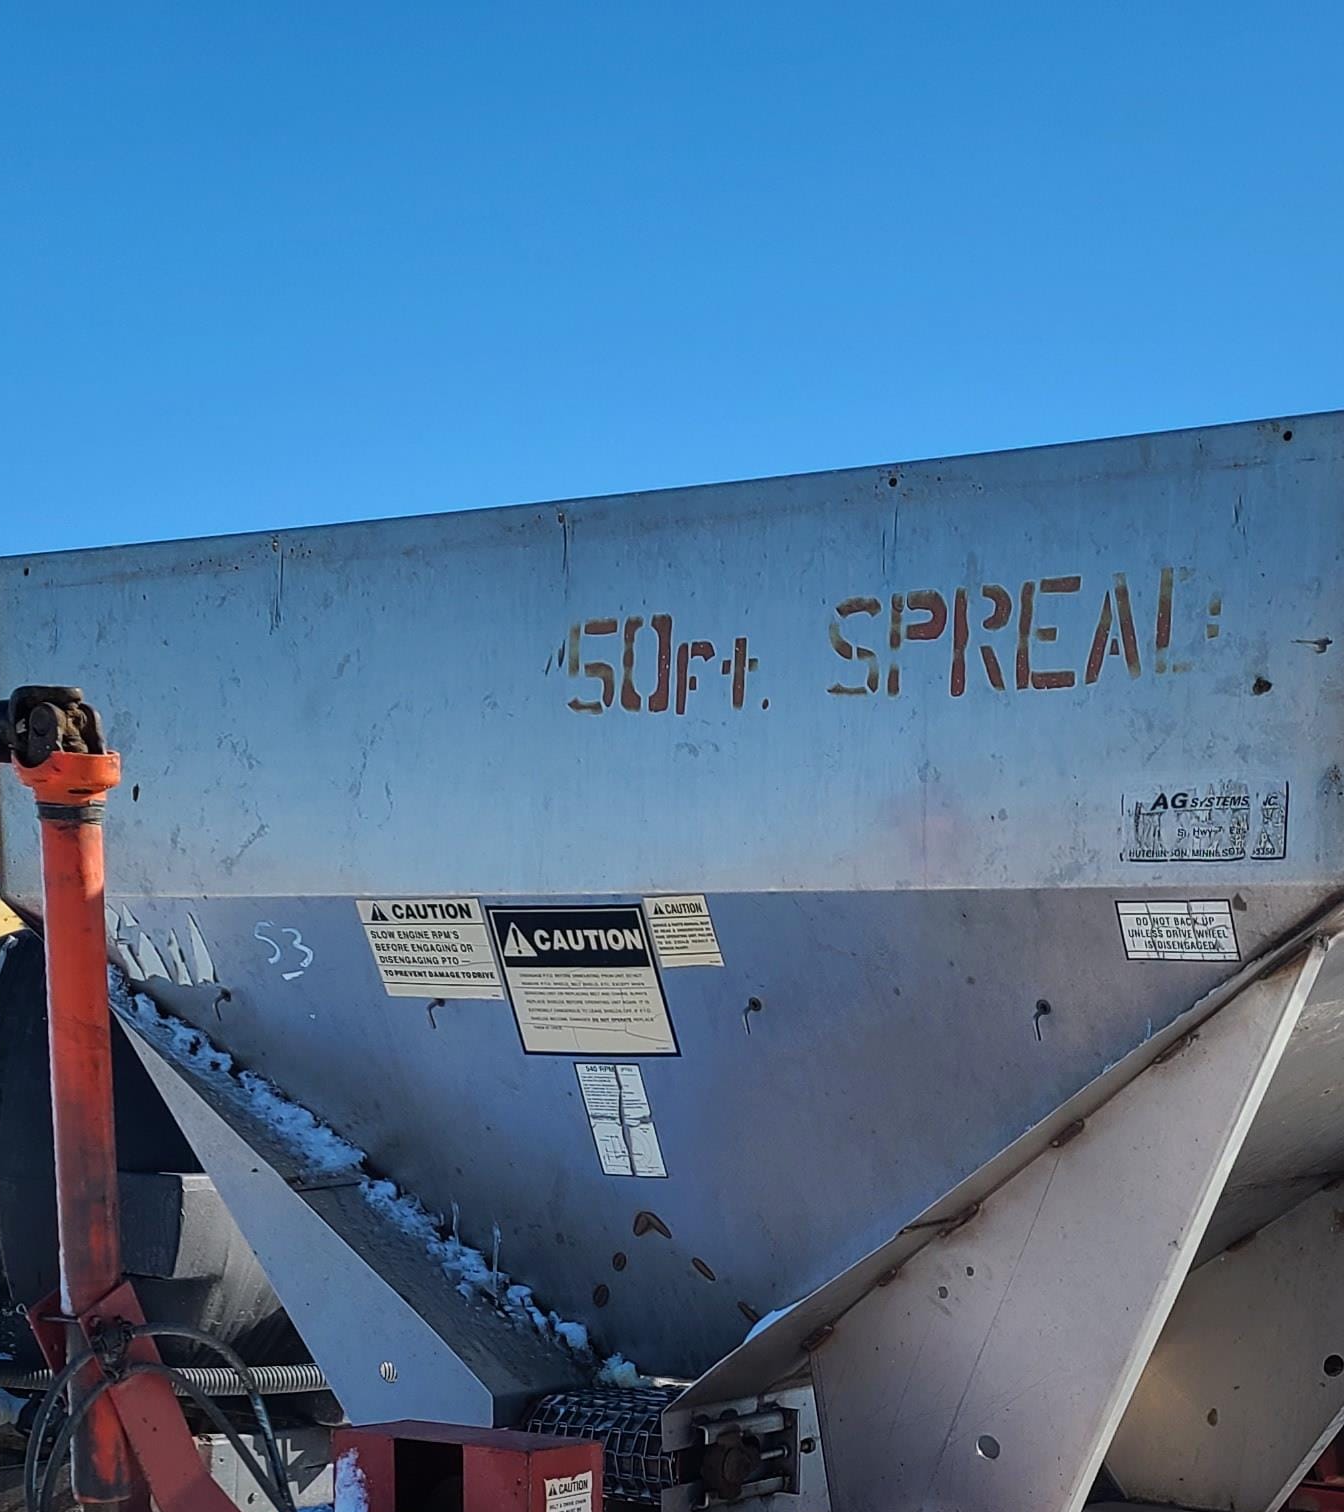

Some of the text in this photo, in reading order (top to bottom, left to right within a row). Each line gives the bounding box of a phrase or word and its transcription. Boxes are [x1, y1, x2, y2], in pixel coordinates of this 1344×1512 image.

[1151, 792, 1188, 810] AG
[391, 903, 472, 919] CAUTION
[664, 902, 703, 914] CAUTION
[1135, 916, 1215, 927] DO NOT BACK UP
[370, 930, 395, 939] SLOW
[397, 930, 430, 939] ENGINE
[533, 928, 644, 951] CAUTION
[1128, 929, 1229, 939] UNLESS DRIVE WHEEL
[375, 943, 473, 953] BEFORE ENGAGING OR
[1144, 940, 1217, 951] IS DISENGAGED
[379, 955, 459, 965] DISENGAGING PTO
[384, 969, 495, 980] TO PREVENT DAMAGE TO DRIVE
[558, 1479, 588, 1495] CAUTION
